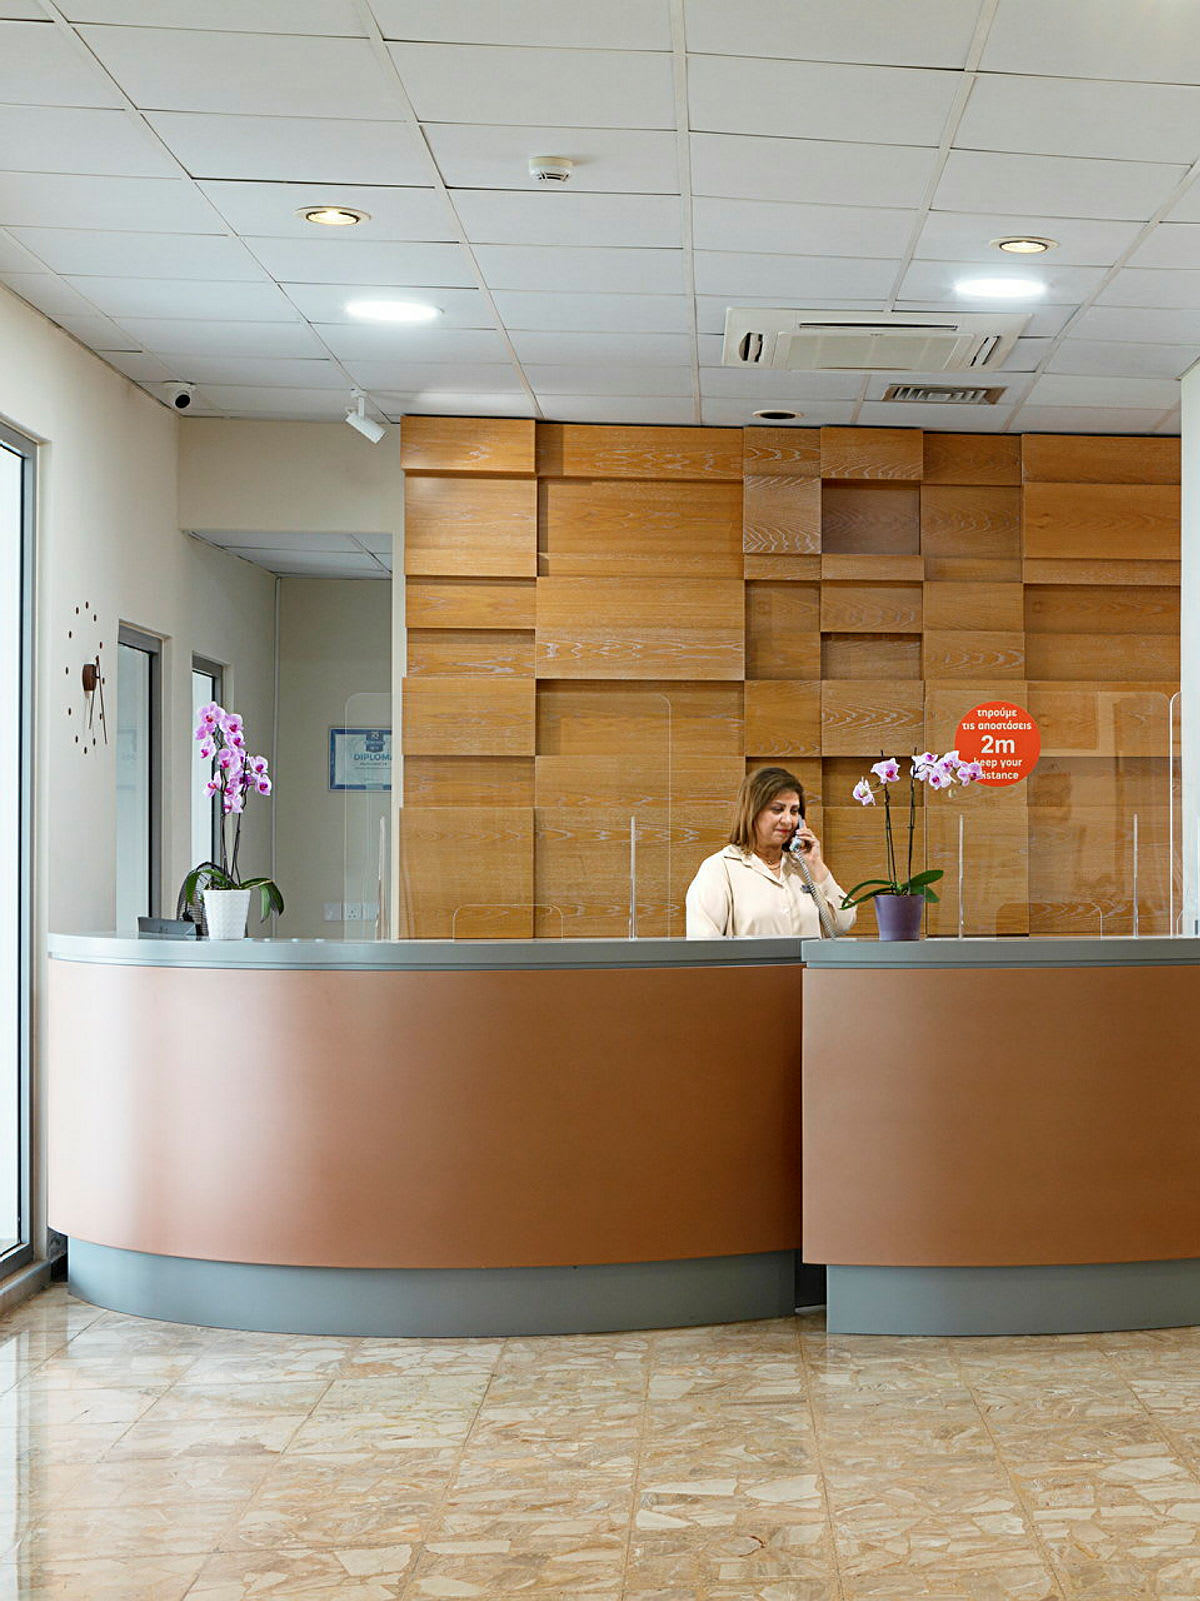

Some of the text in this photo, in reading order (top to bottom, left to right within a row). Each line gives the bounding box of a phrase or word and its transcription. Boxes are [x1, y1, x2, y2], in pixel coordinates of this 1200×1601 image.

[977, 707, 1017, 719] τηρούμε
[981, 734, 1015, 754] 2m
[1000, 759, 1023, 768] your
[980, 770, 1019, 780] istance
